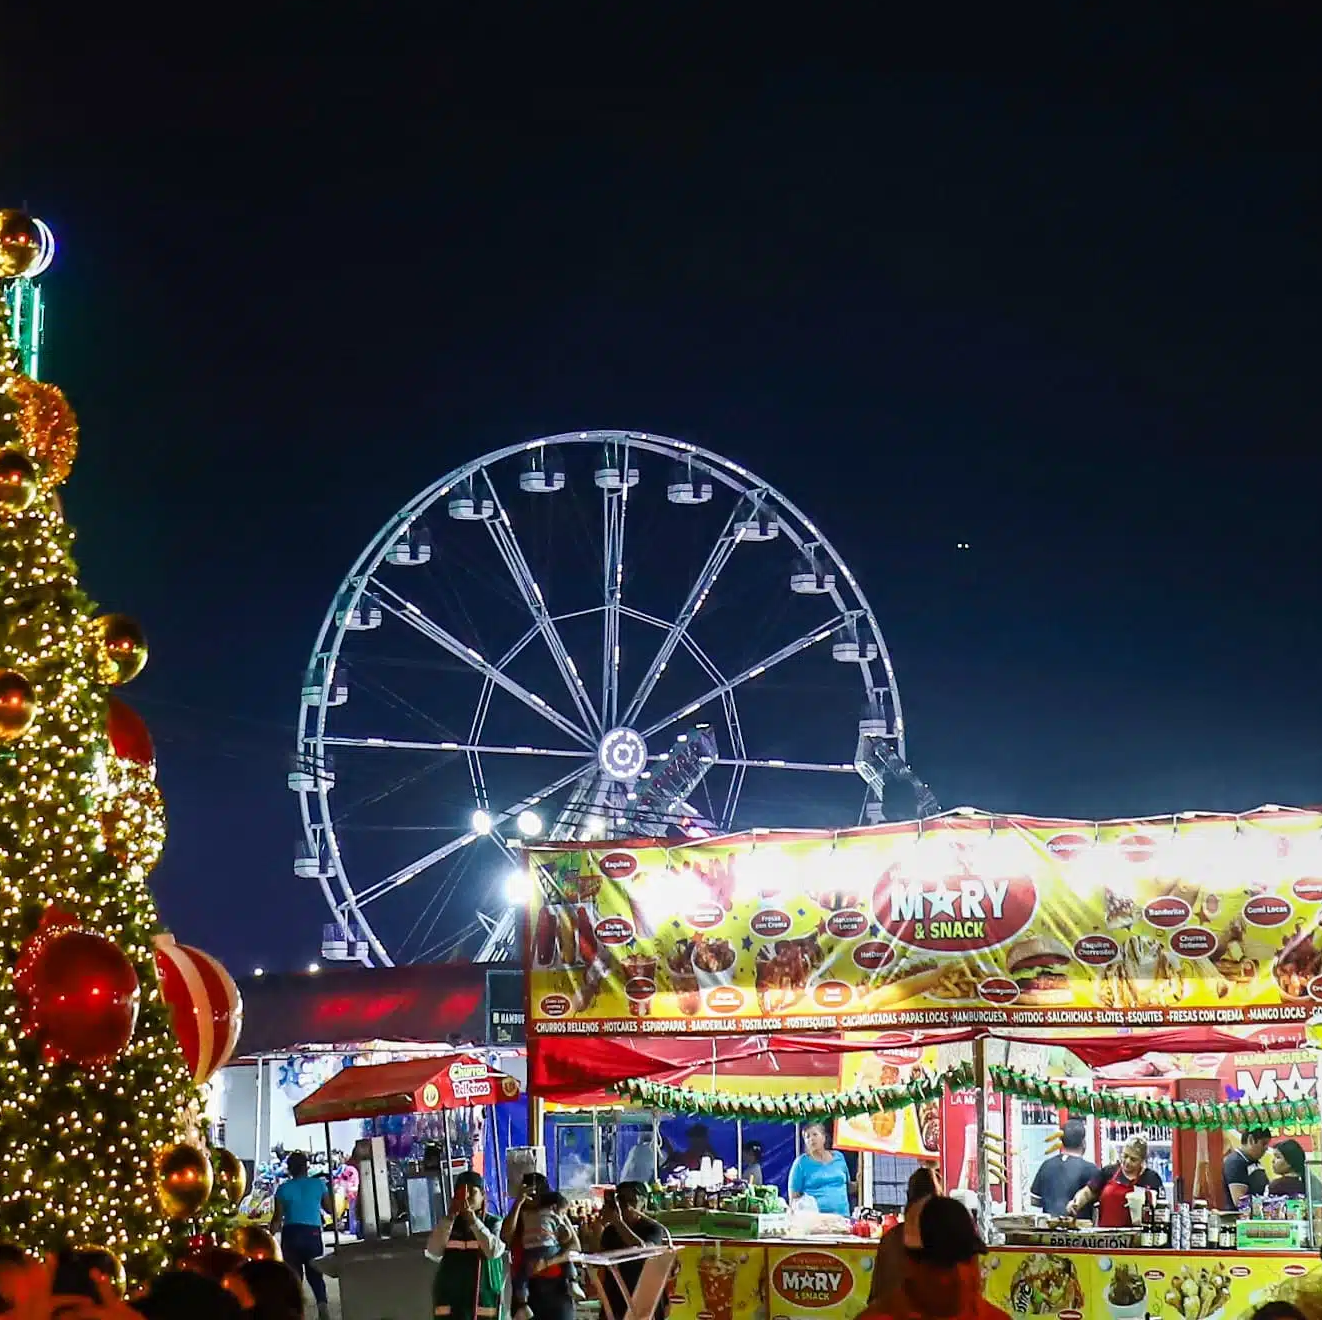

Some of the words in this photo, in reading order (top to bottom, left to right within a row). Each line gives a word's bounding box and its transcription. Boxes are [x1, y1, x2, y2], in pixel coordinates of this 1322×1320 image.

[889, 878, 1009, 921] MARY
[914, 923, 926, 940] &
[929, 921, 985, 939] SNACK
[567, 1021, 599, 1033] RELLENOS
[925, 1011, 949, 1023] LOCAS
[1198, 1010, 1217, 1022] CON
[1217, 1009, 1245, 1022] CREMA
[1280, 1007, 1307, 1020] LOCAS
[450, 1064, 487, 1078] Churros
[454, 1081, 490, 1096] Rellenos
[782, 1270, 843, 1292] MARY
